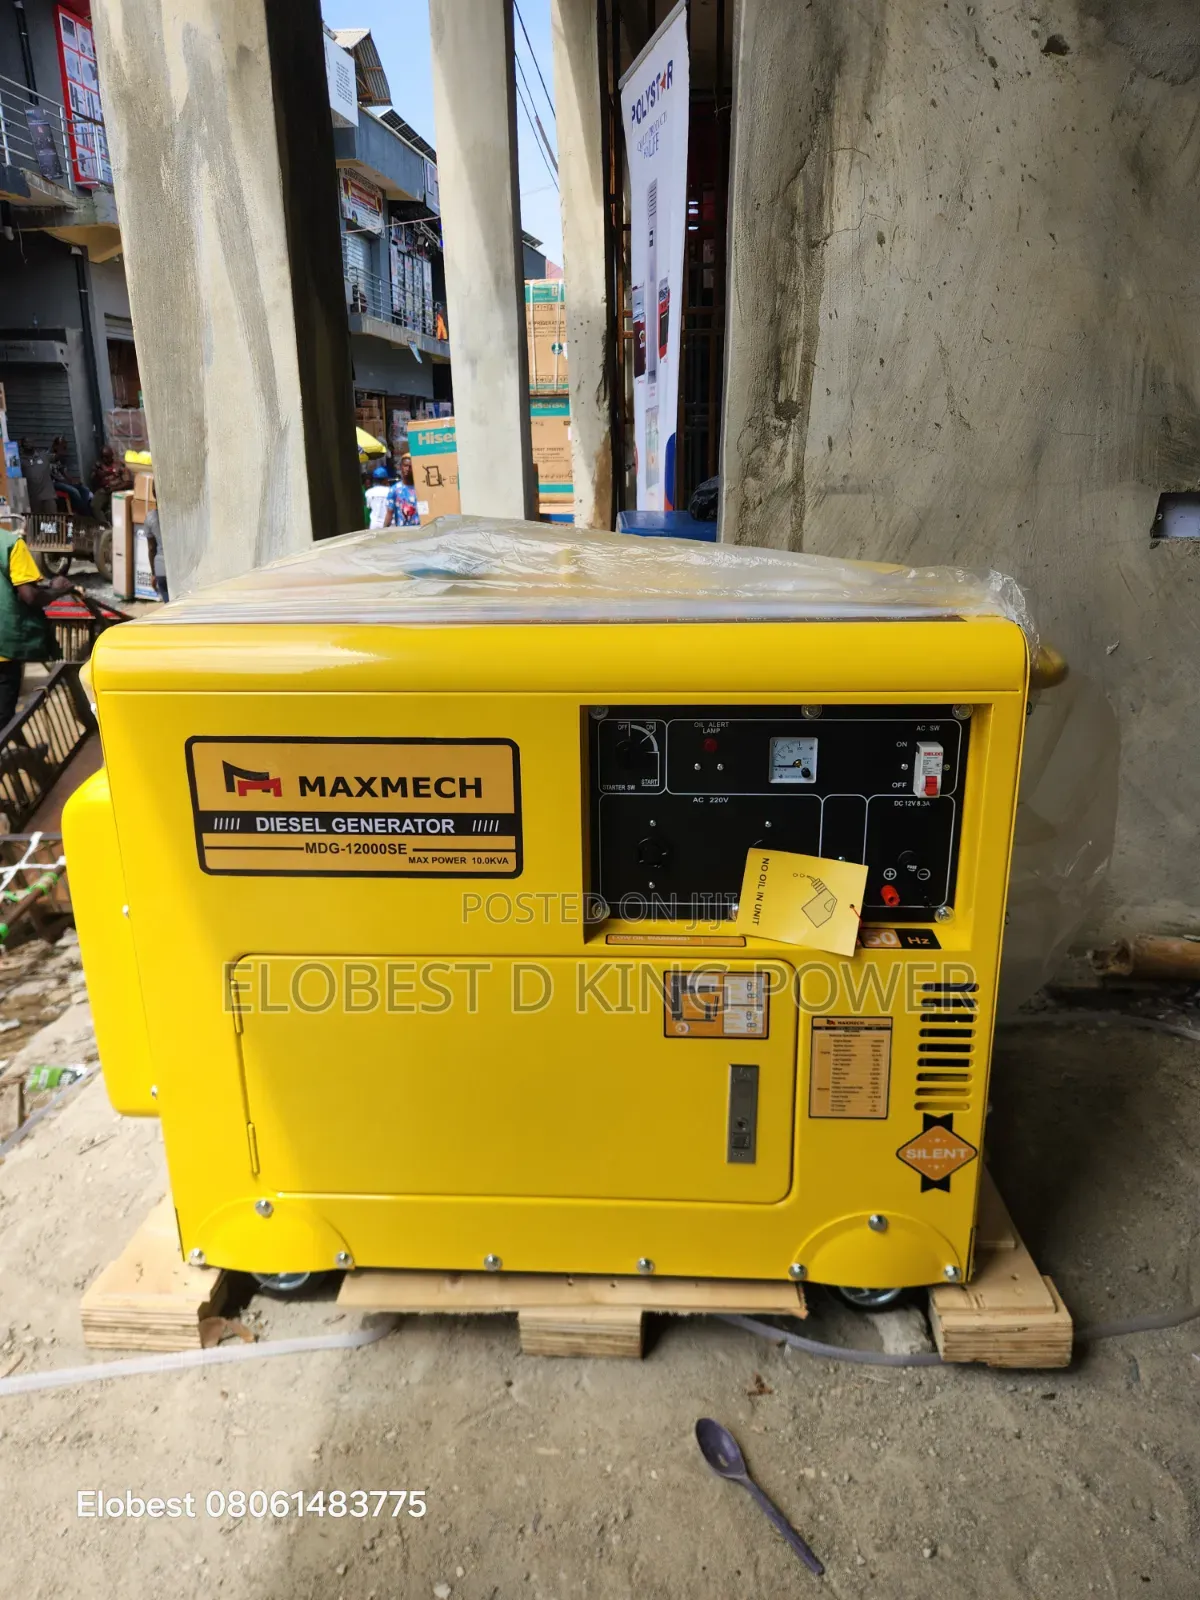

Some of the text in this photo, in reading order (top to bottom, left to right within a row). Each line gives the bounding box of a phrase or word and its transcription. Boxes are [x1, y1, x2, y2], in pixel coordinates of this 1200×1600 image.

[298, 775, 483, 799] MAXMECH
[891, 781, 908, 789] OFF
[709, 796, 729, 804] 220V
[255, 816, 456, 835] DIESEL GENERATOR
[304, 842, 408, 856] MDG-12000SE
[408, 857, 510, 866] MAX POWER 10.0KVA
[752, 857, 770, 926] NO OIL IN UNIT
[906, 935, 931, 945] Hz
[905, 1147, 969, 1160] SILENT
